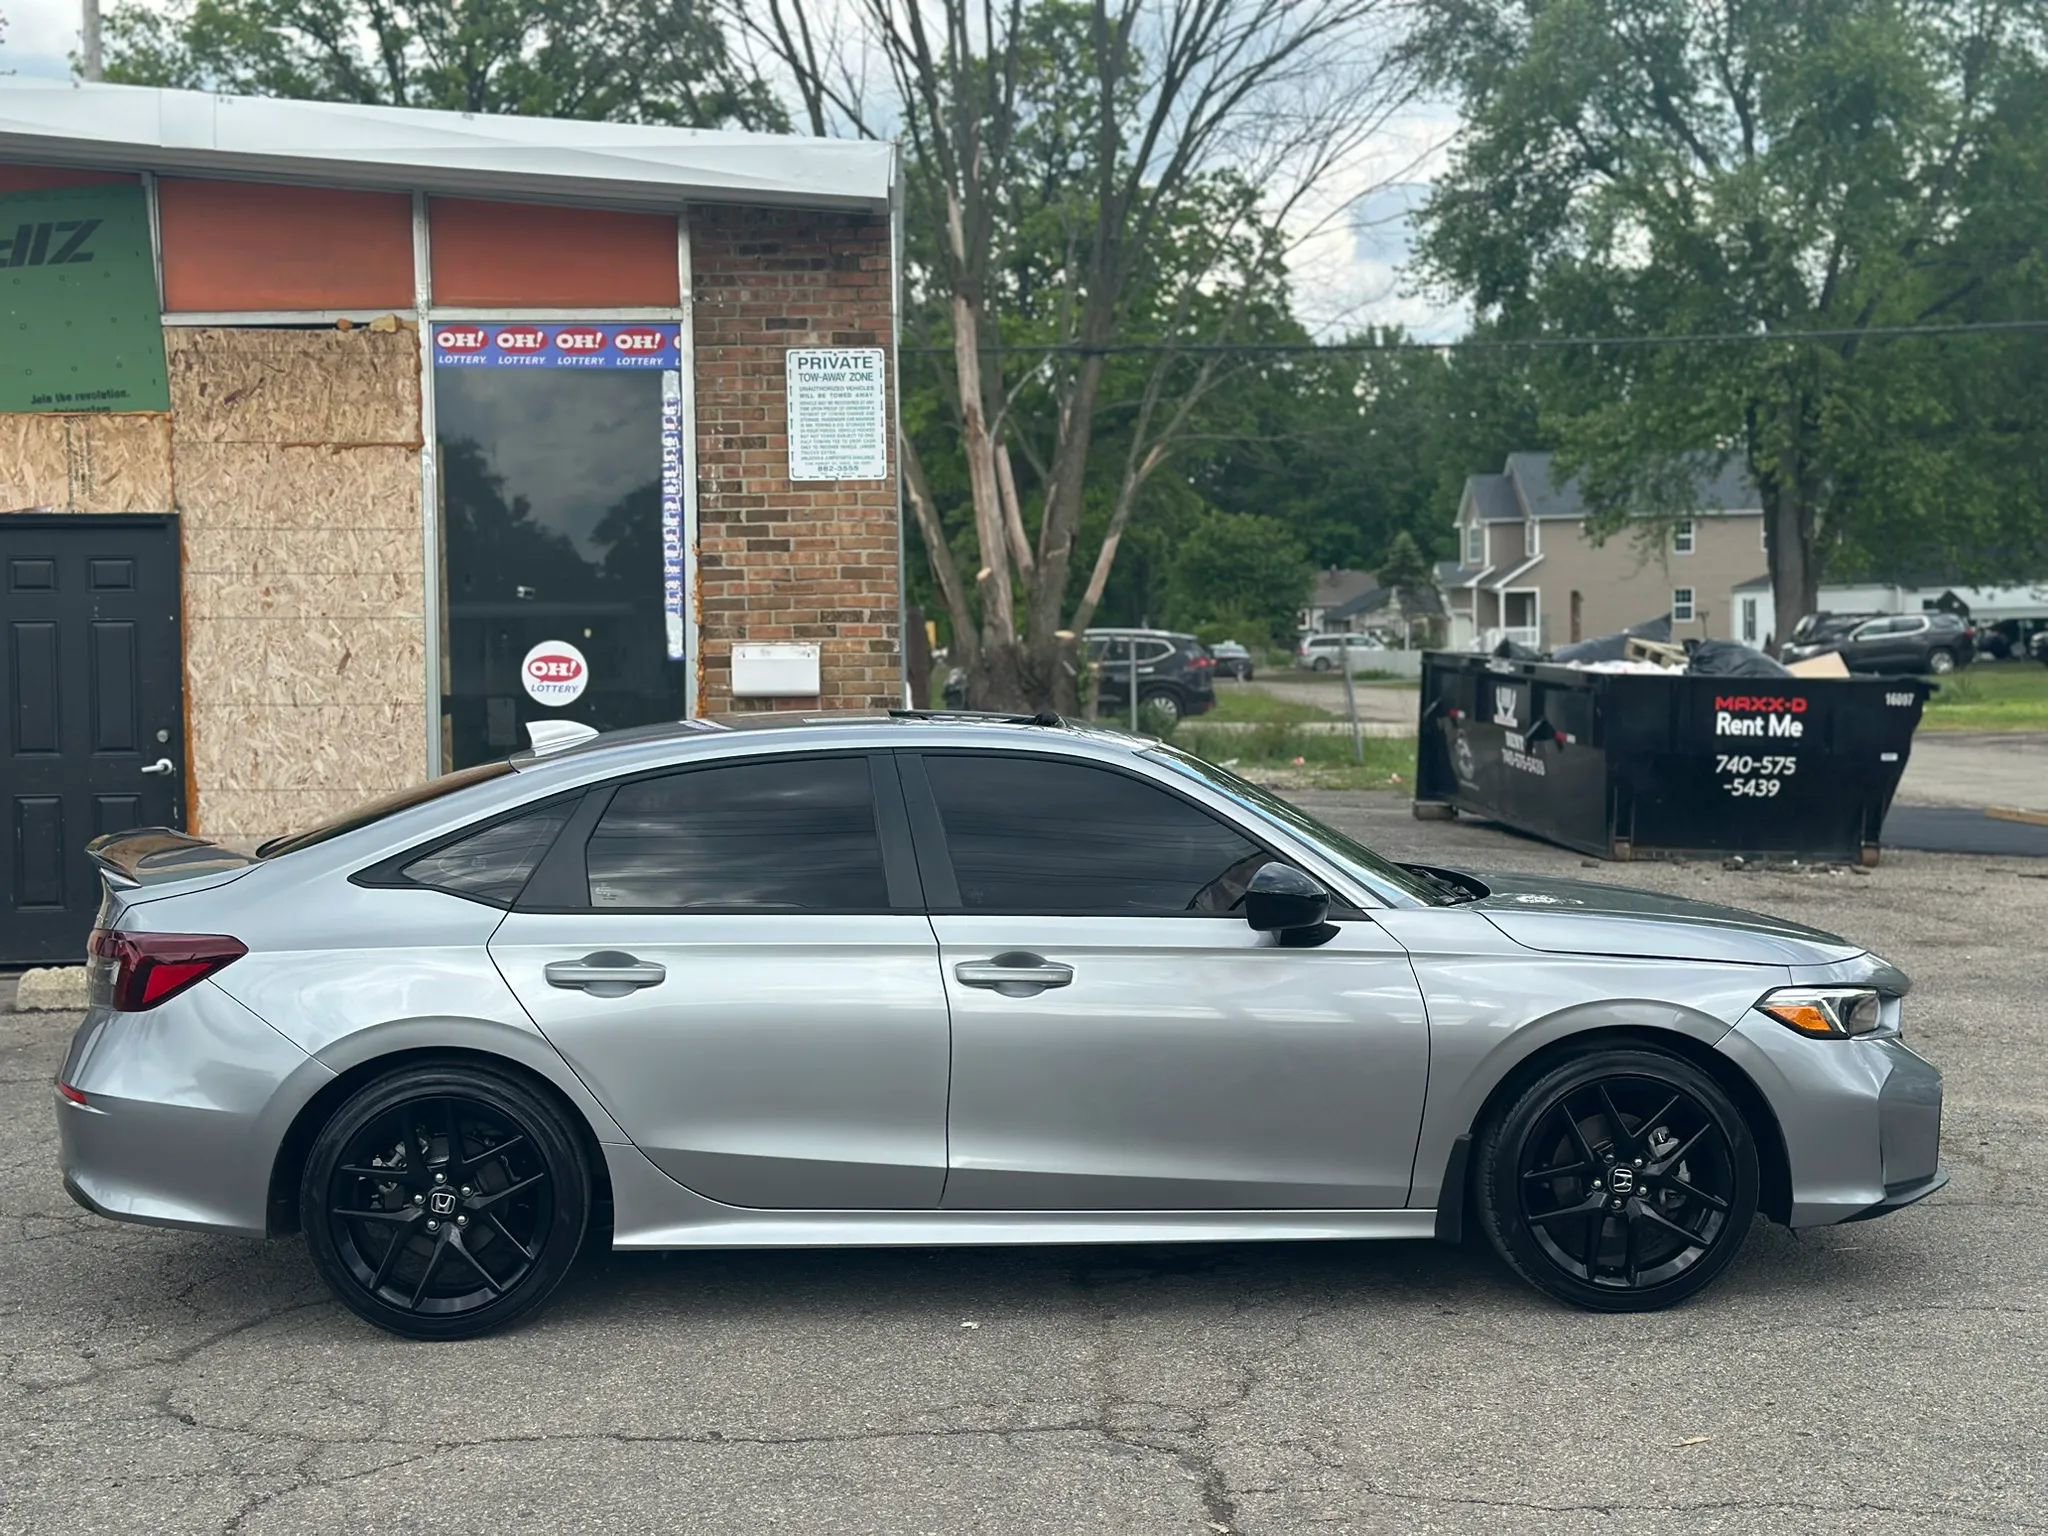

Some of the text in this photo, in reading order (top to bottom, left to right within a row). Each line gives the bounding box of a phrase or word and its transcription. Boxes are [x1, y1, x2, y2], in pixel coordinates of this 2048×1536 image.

[437, 330, 483, 347] OH!
[496, 331, 542, 348] OH!
[555, 332, 602, 349] OH!
[614, 332, 661, 350] OH!
[438, 355, 486, 364] LOTTERY
[498, 356, 545, 365] LOTTERY
[557, 357, 604, 365] LOTTERY
[616, 357, 663, 366] LOTTERY
[798, 356, 873, 369] PRIVATE
[798, 372, 873, 382] TOW-AWAY ZONE
[55, 393, 72, 402] the
[530, 660, 577, 677] OH!
[531, 684, 577, 693] LOTTERY
[1715, 711, 1804, 737] Rent Me
[1714, 755, 1796, 774] 740-575
[1723, 779, 1780, 797] -5439
